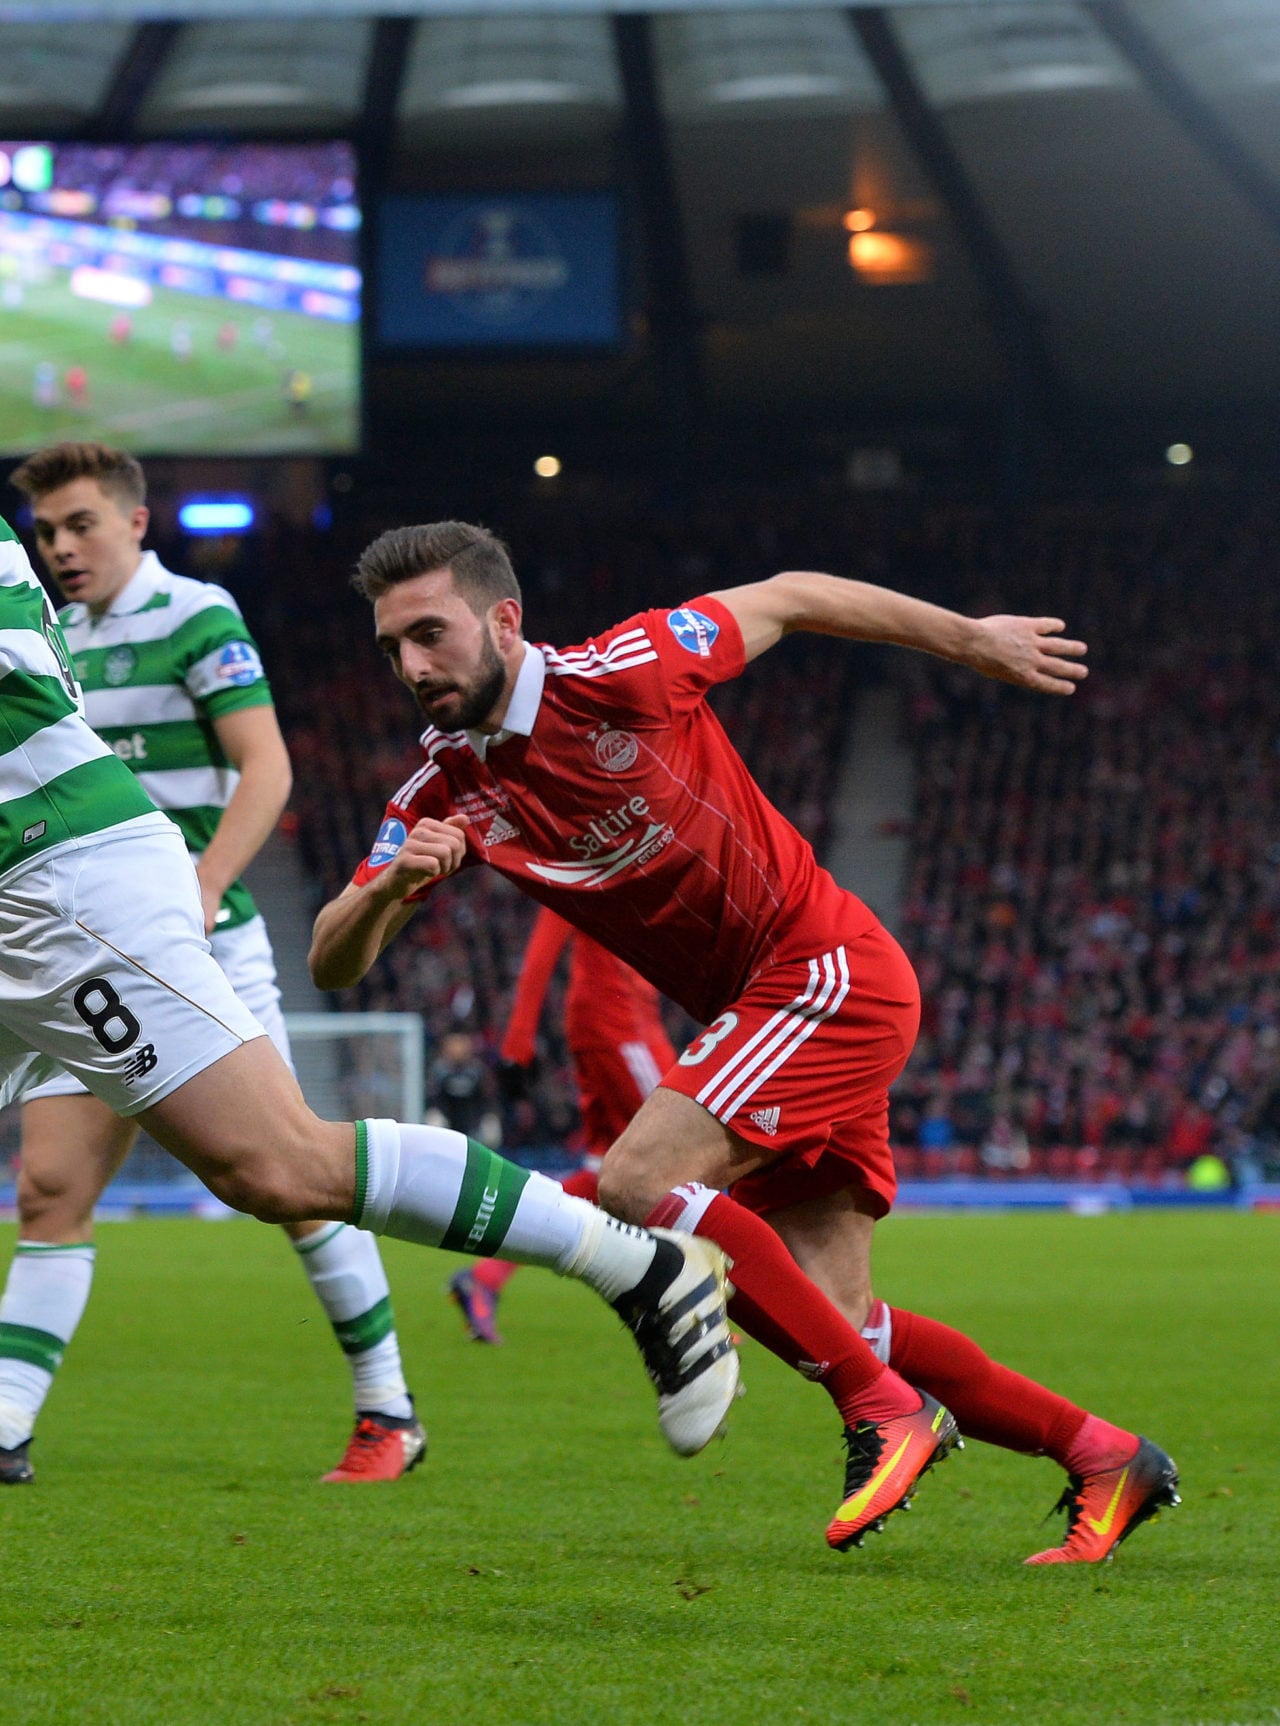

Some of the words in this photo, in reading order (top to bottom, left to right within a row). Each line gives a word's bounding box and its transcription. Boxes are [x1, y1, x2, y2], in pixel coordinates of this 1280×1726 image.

[106, 732, 147, 761] et
[483, 825, 521, 847] adidas
[569, 796, 650, 860] Saltire
[637, 825, 675, 865] energy
[73, 977, 142, 1055] 8
[678, 1011, 739, 1067] 3
[750, 1111, 778, 1137] adidas
